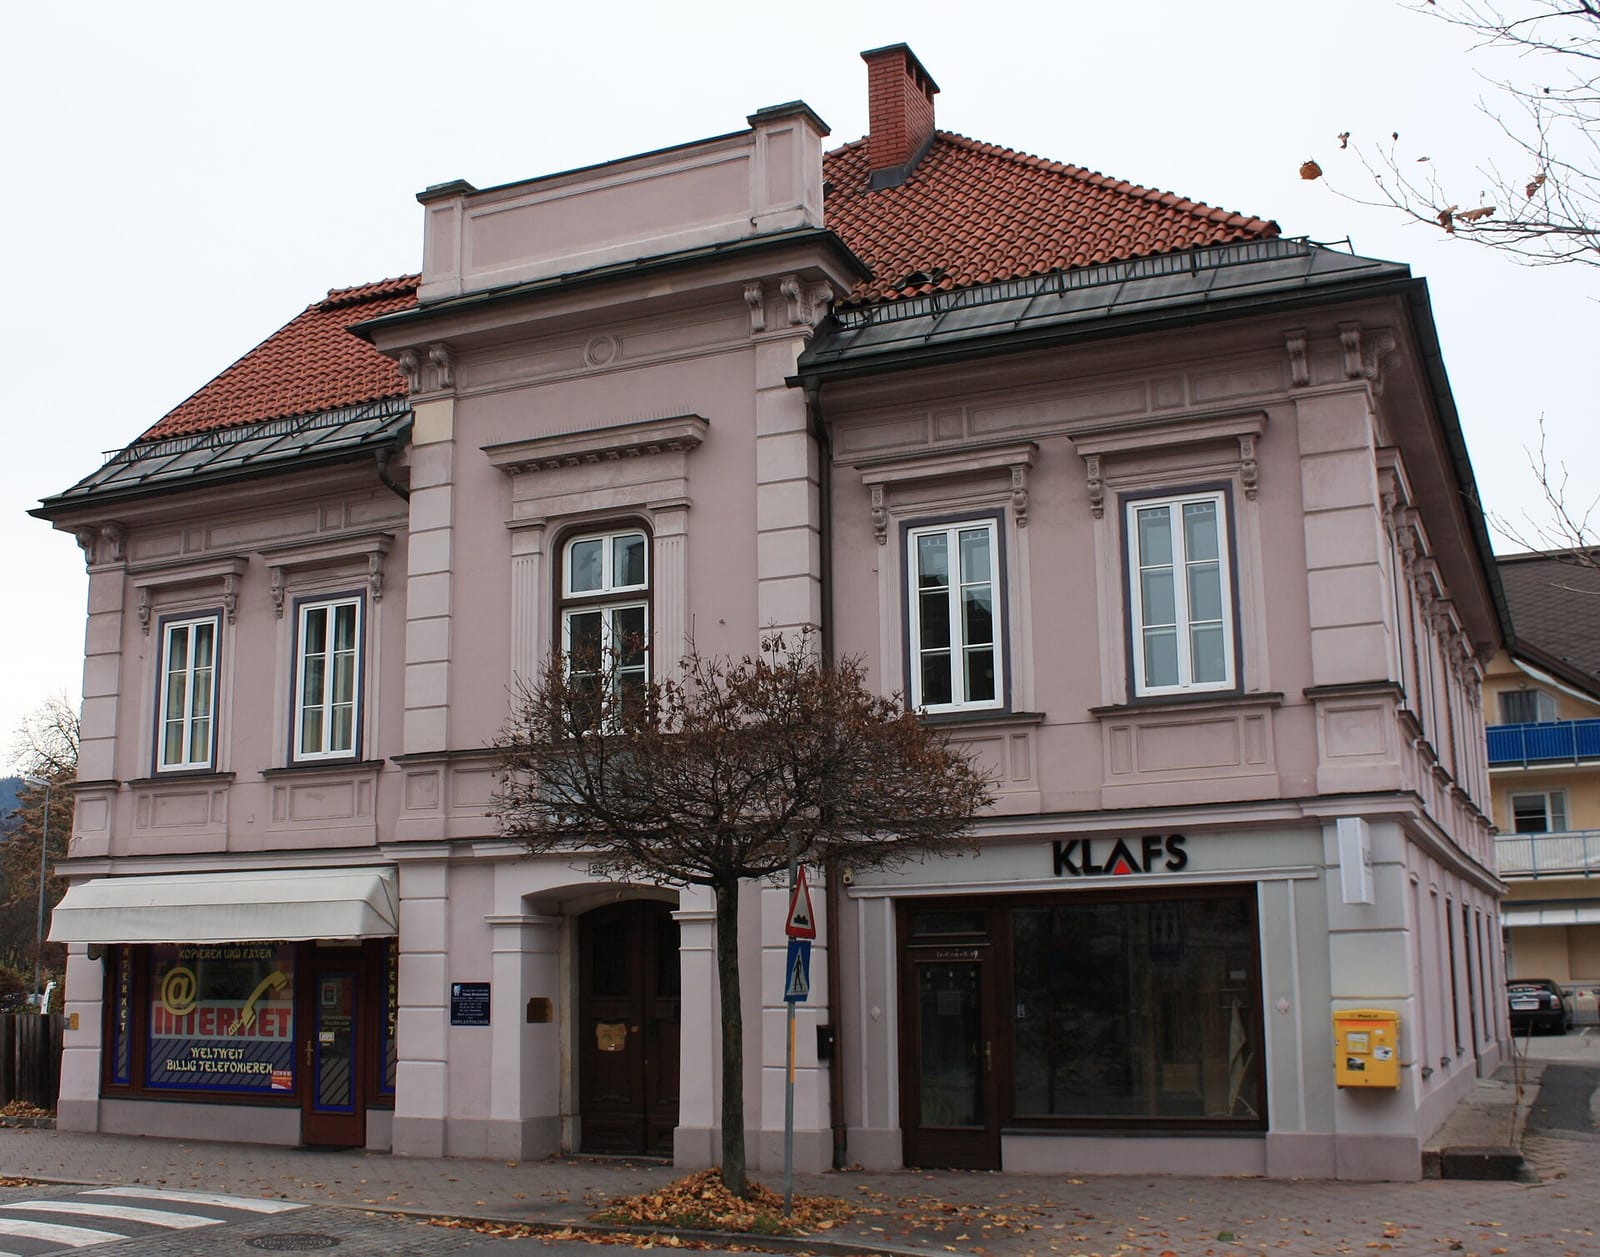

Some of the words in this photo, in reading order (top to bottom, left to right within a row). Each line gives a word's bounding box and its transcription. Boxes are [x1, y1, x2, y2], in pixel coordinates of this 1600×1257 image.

[1053, 834, 1188, 876] KLAFS
[120, 945, 129, 1032] NTERNET
[387, 938, 397, 1036] NTERNET
[167, 1059, 197, 1071] BILLIG
[199, 1061, 273, 1074] TELEFONIEREN
[191, 1047, 245, 1060] WELTWEIT
